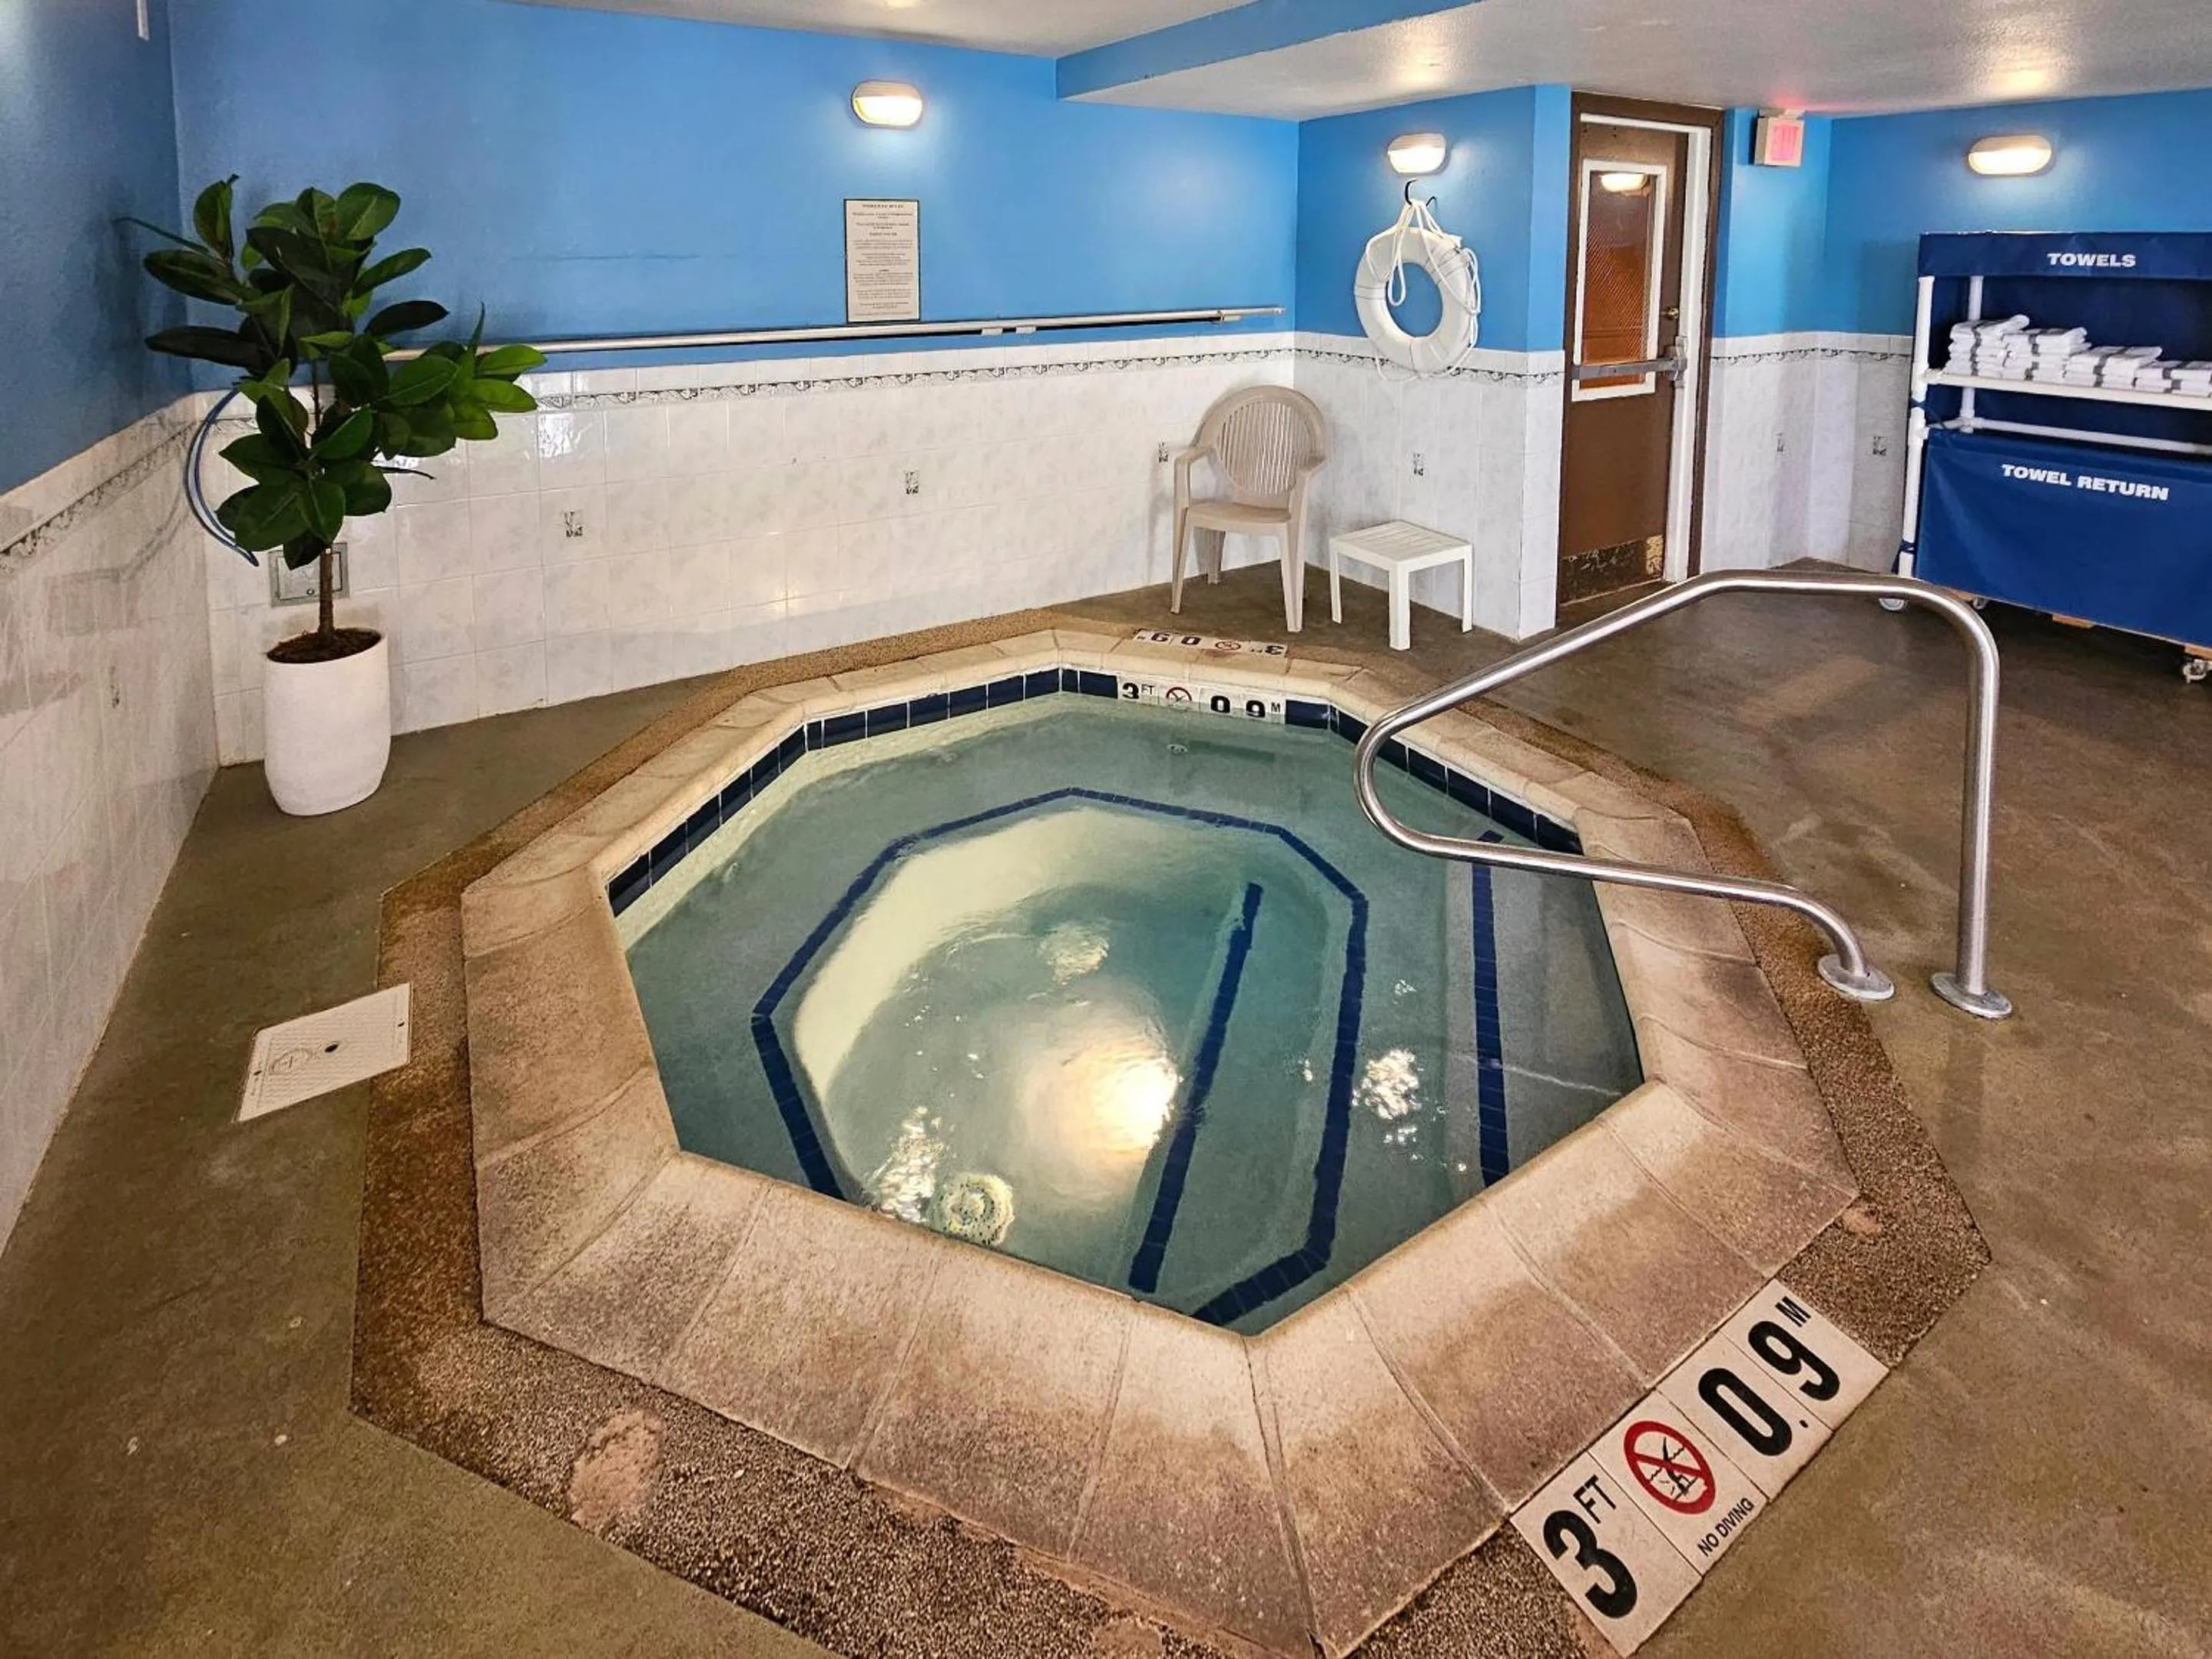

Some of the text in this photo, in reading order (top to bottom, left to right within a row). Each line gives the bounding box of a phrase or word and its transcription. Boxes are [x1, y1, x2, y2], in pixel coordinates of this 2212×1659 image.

[2046, 253, 2137, 267] TOWELS
[2002, 463, 2170, 501] TOWEL RETURN
[1122, 682, 1139, 700] 3
[1141, 684, 1154, 695] FT
[1271, 702, 1280, 713] M
[1775, 1296, 1812, 1328] M
[1573, 1475, 1617, 1524] FT
[1697, 1498, 1754, 1557] NO DIVING
[1542, 1509, 1637, 1619] 3
